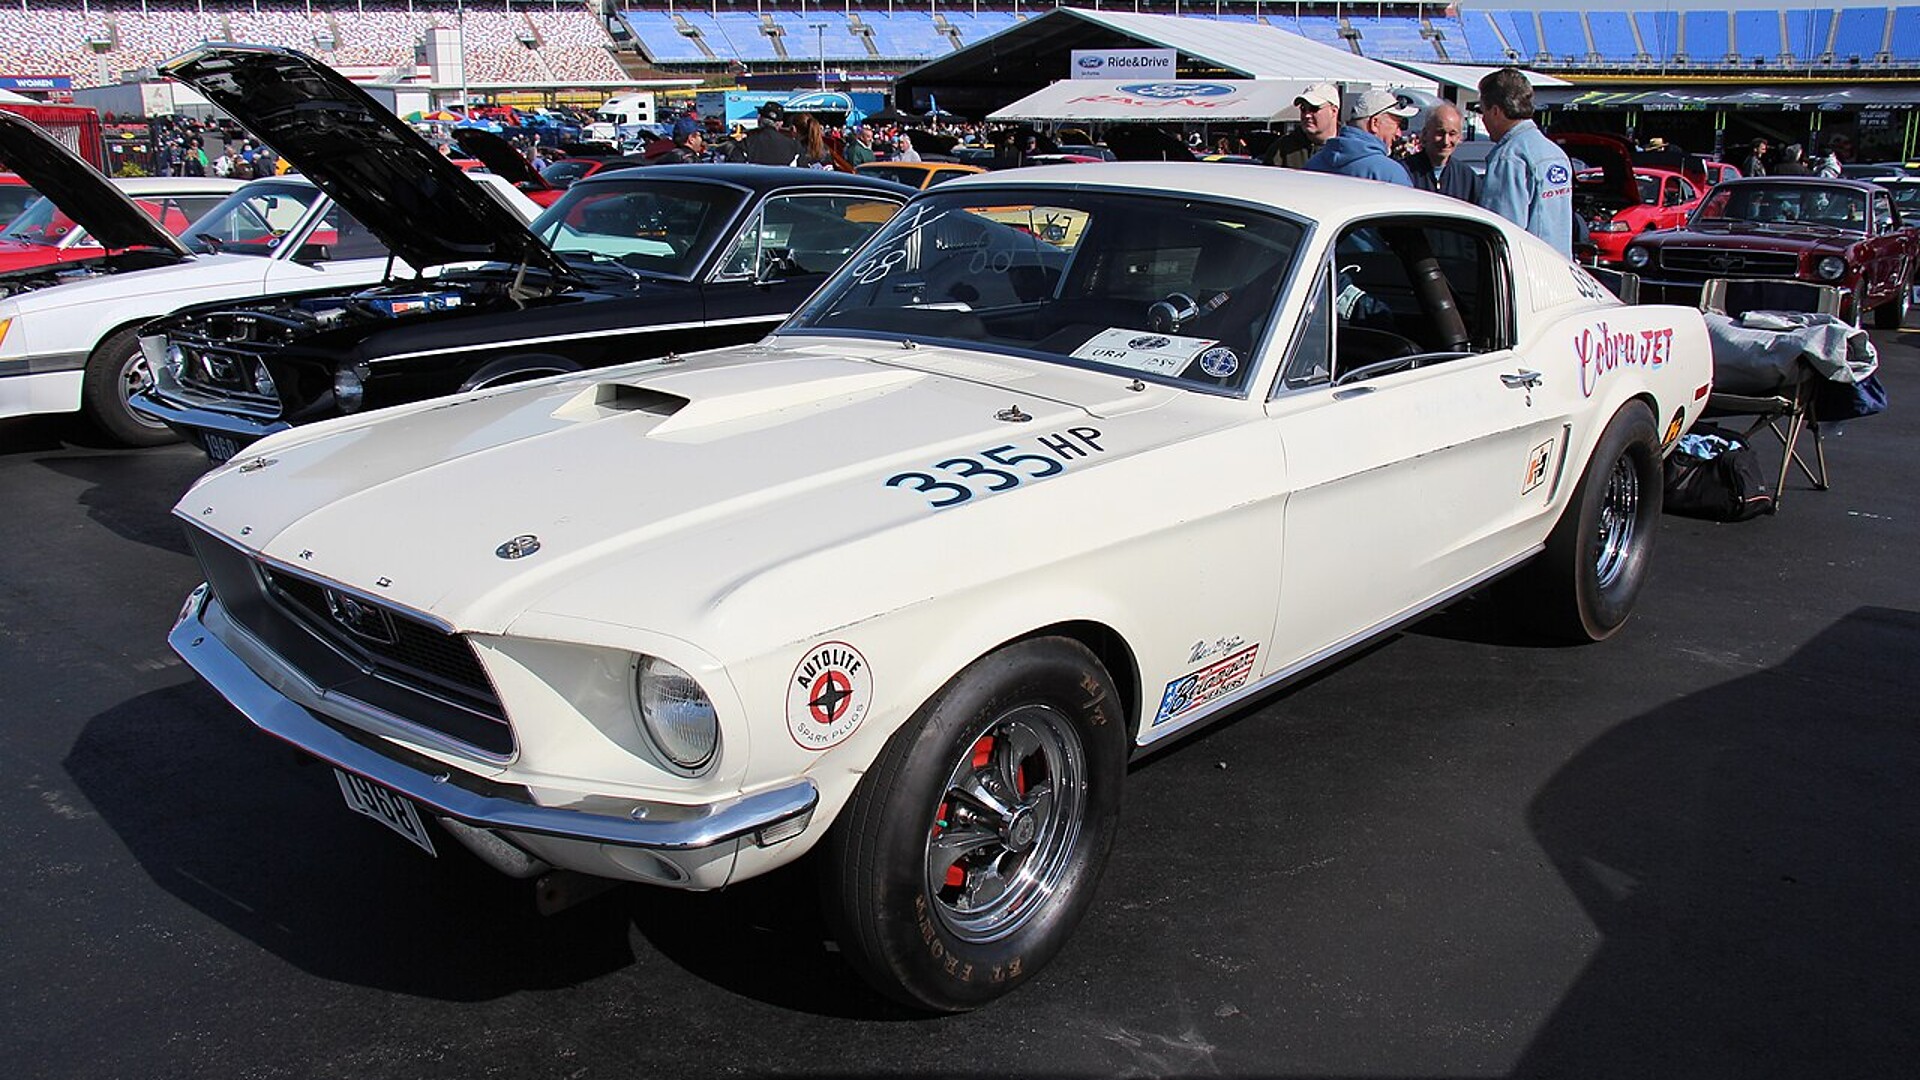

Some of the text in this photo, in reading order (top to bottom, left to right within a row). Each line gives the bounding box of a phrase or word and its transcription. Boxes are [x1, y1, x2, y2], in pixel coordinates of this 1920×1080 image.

[1107, 56, 1169, 68] Ride&Drive
[15, 78, 55, 88] WOMEN
[1574, 322, 1673, 398] Cobra JET
[885, 426, 1105, 508] 335 HP
[797, 649, 862, 690] AUTOLITE
[797, 703, 864, 743] SPARK PLUGS
[344, 772, 419, 837] 1968
